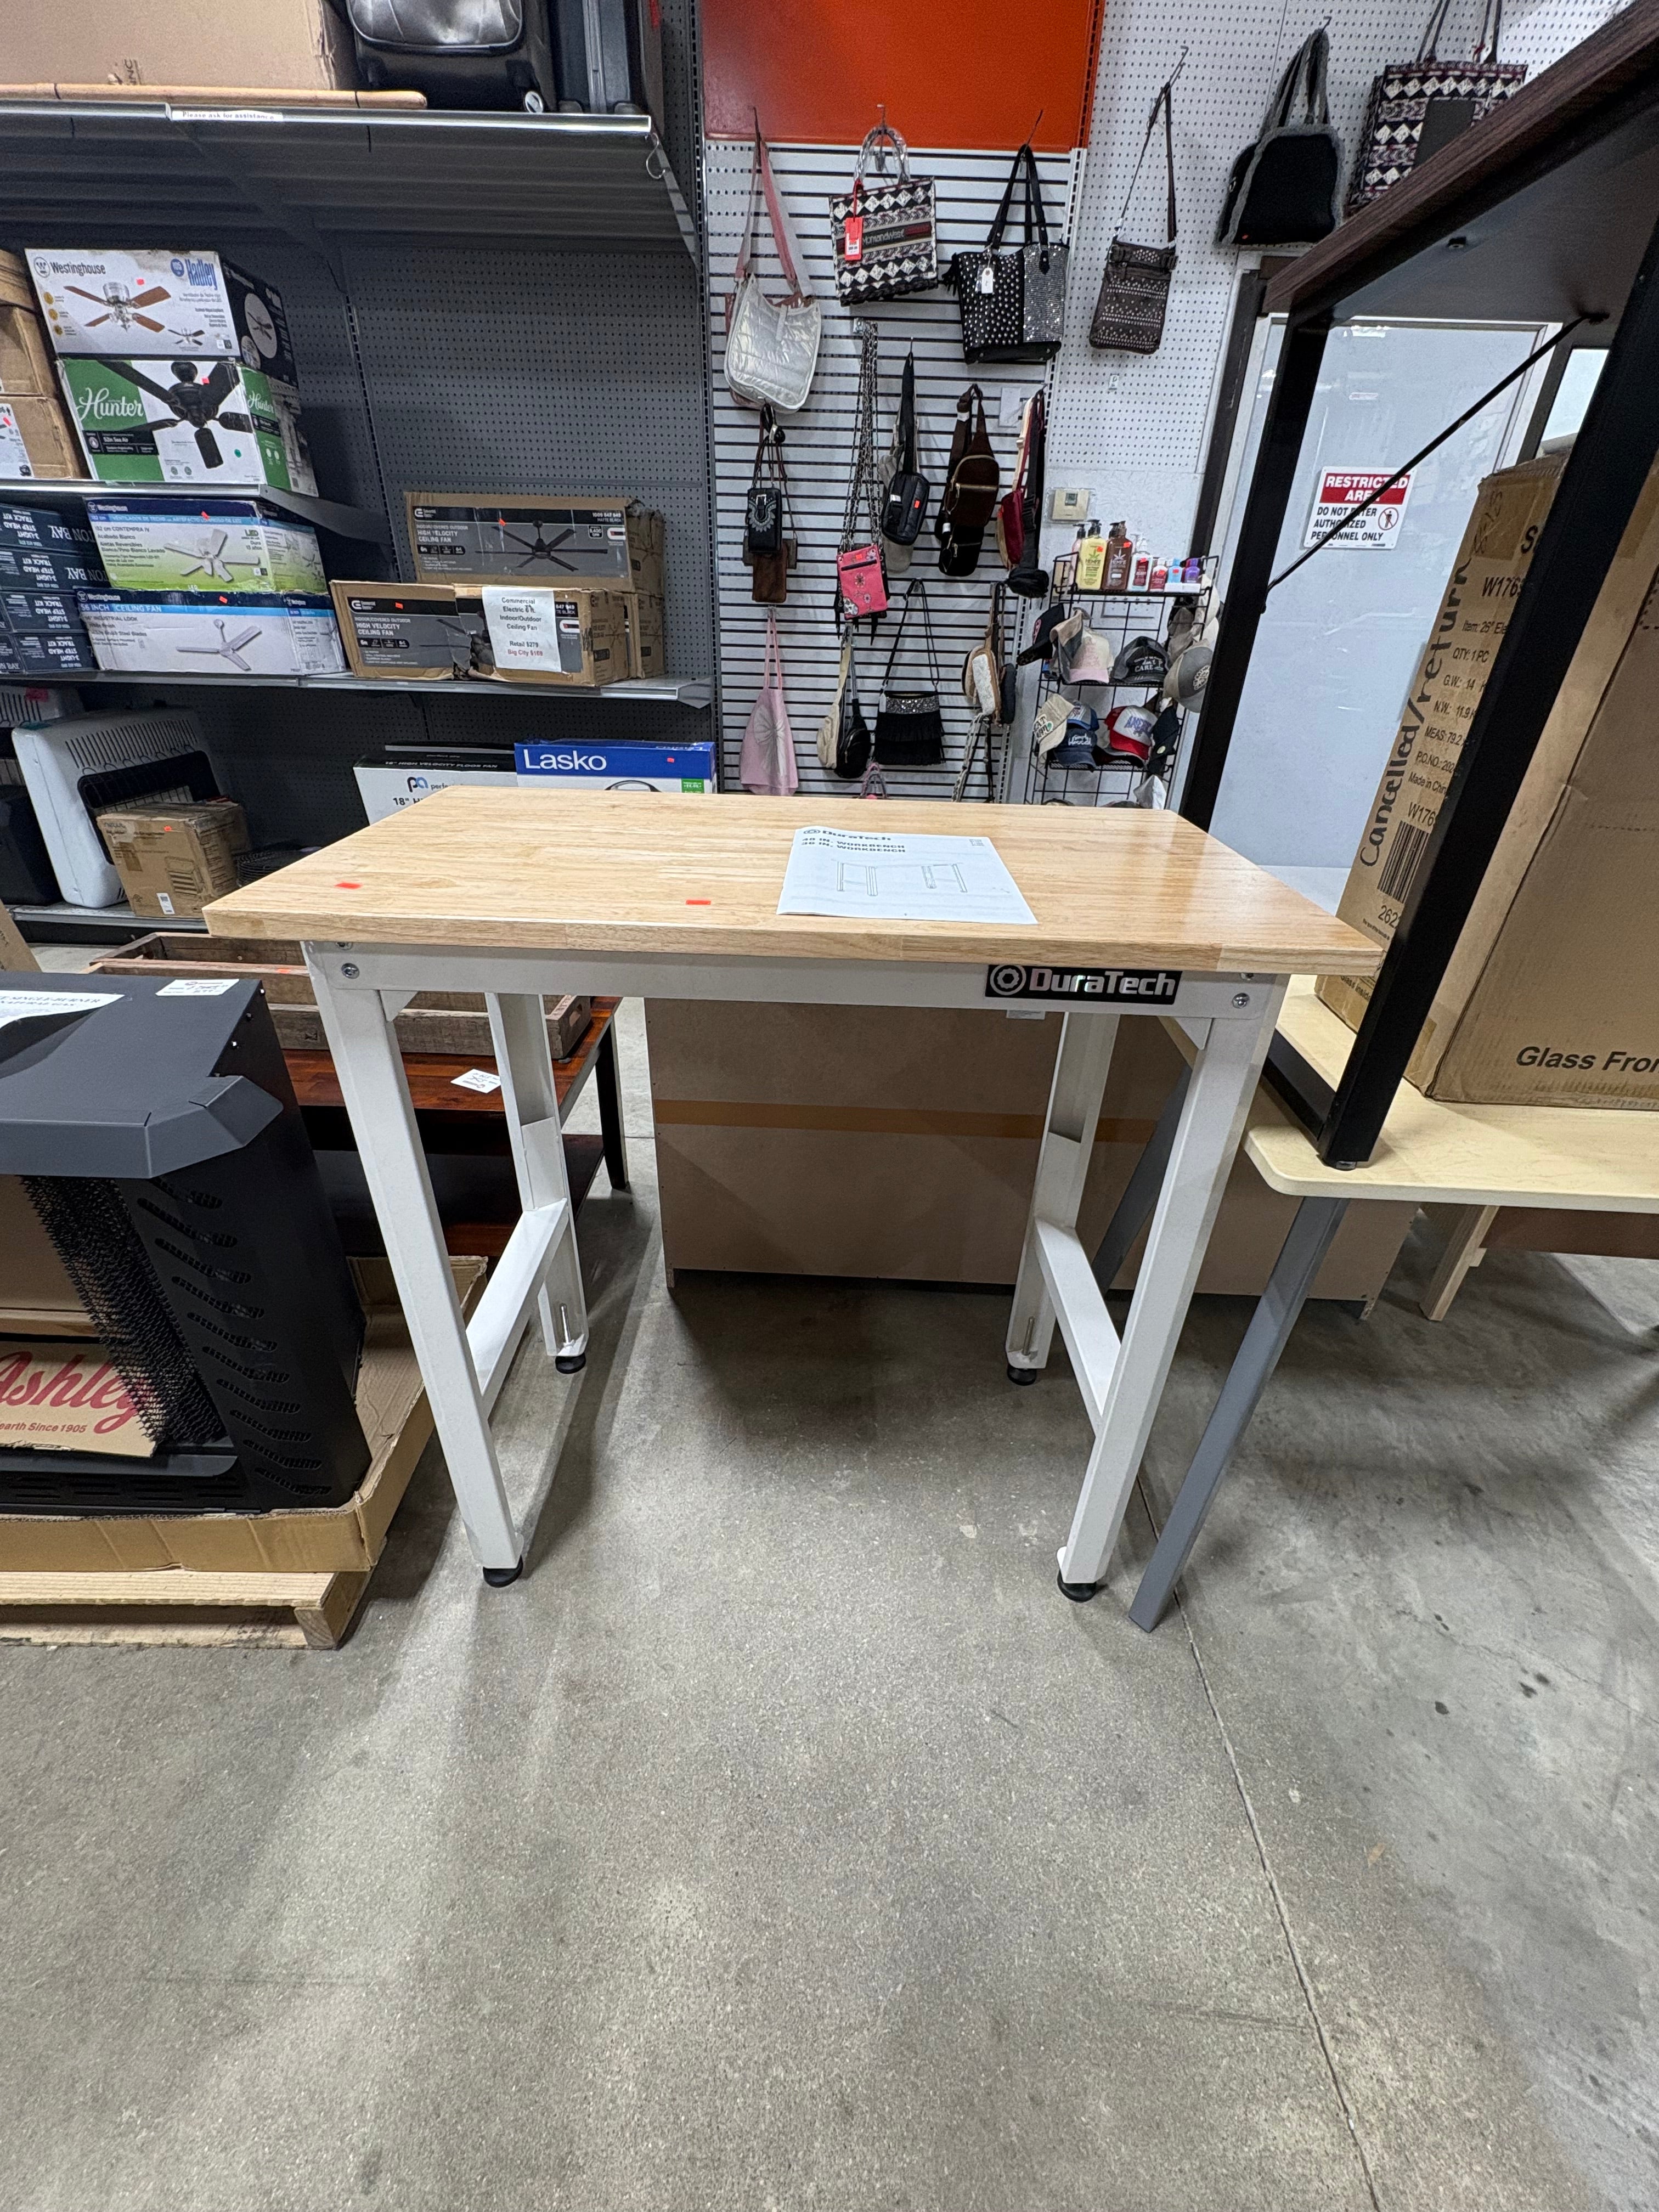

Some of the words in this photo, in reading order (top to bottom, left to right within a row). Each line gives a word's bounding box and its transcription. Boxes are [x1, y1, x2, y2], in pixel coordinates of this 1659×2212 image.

[50, 262, 106, 276] Westinghouse
[184, 258, 218, 290] Hadley
[76, 387, 144, 421] Hunter
[247, 391, 274, 413] Hunter
[1325, 476, 1408, 489] RESTRICED
[1317, 507, 1329, 516] DO
[1330, 507, 1348, 516] NOT
[47, 525, 72, 540] BAY
[1361, 532, 1384, 541] ONLY
[64, 567, 87, 580] BAY
[1453, 647, 1471, 660] QTY:
[1477, 651, 1489, 663] PC
[1135, 664, 1154, 673] CARE
[1466, 679, 1476, 690] 14
[523, 749, 607, 771] Lasko
[1441, 760, 1456, 774] 202
[1408, 771, 1426, 787] Made
[1425, 777, 1433, 789] in
[393, 798, 410, 806] 18"
[822, 830, 891, 841] DuraTech
[1378, 905, 1402, 929] 262
[1029, 968, 1176, 996] DuraTech
[1516, 1046, 1596, 1070] Glass
[28, 1423, 59, 1432] Since
[60, 1424, 88, 1433] 1905
